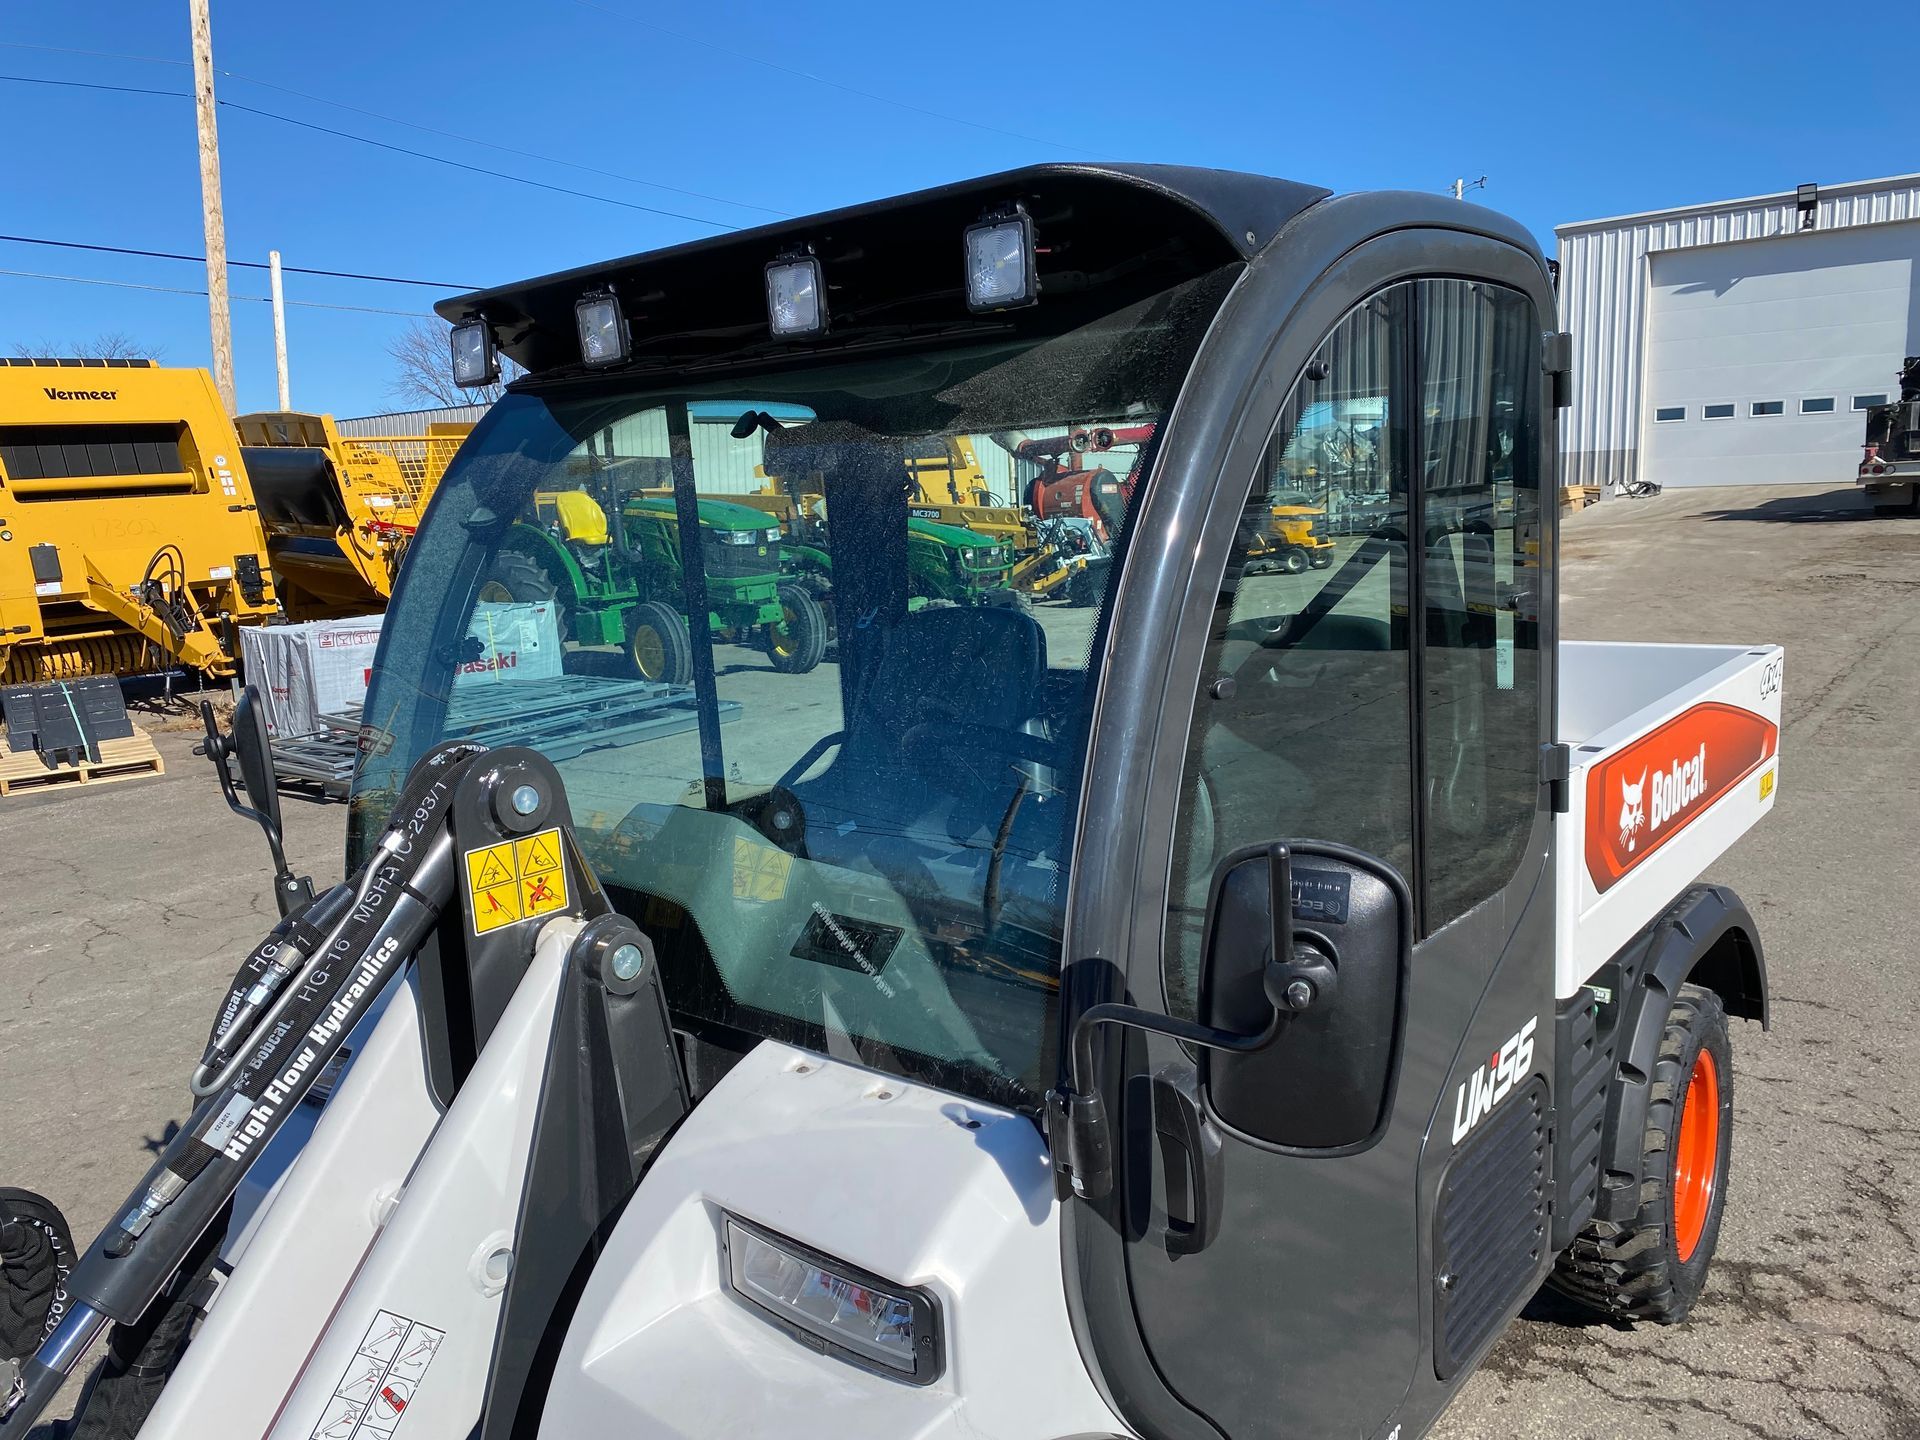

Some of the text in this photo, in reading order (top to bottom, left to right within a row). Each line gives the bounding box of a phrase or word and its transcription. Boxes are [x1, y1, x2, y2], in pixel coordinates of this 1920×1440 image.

[43, 387, 118, 401] Vermeer
[912, 509, 940, 519] MC3700
[1760, 656, 1783, 700] 4x4
[1651, 742, 1706, 832] Bobcat
[298, 938, 350, 1002] HG-16
[224, 936, 399, 1161] High Flow Hydraulics
[250, 1019, 291, 1070] Bobcat
